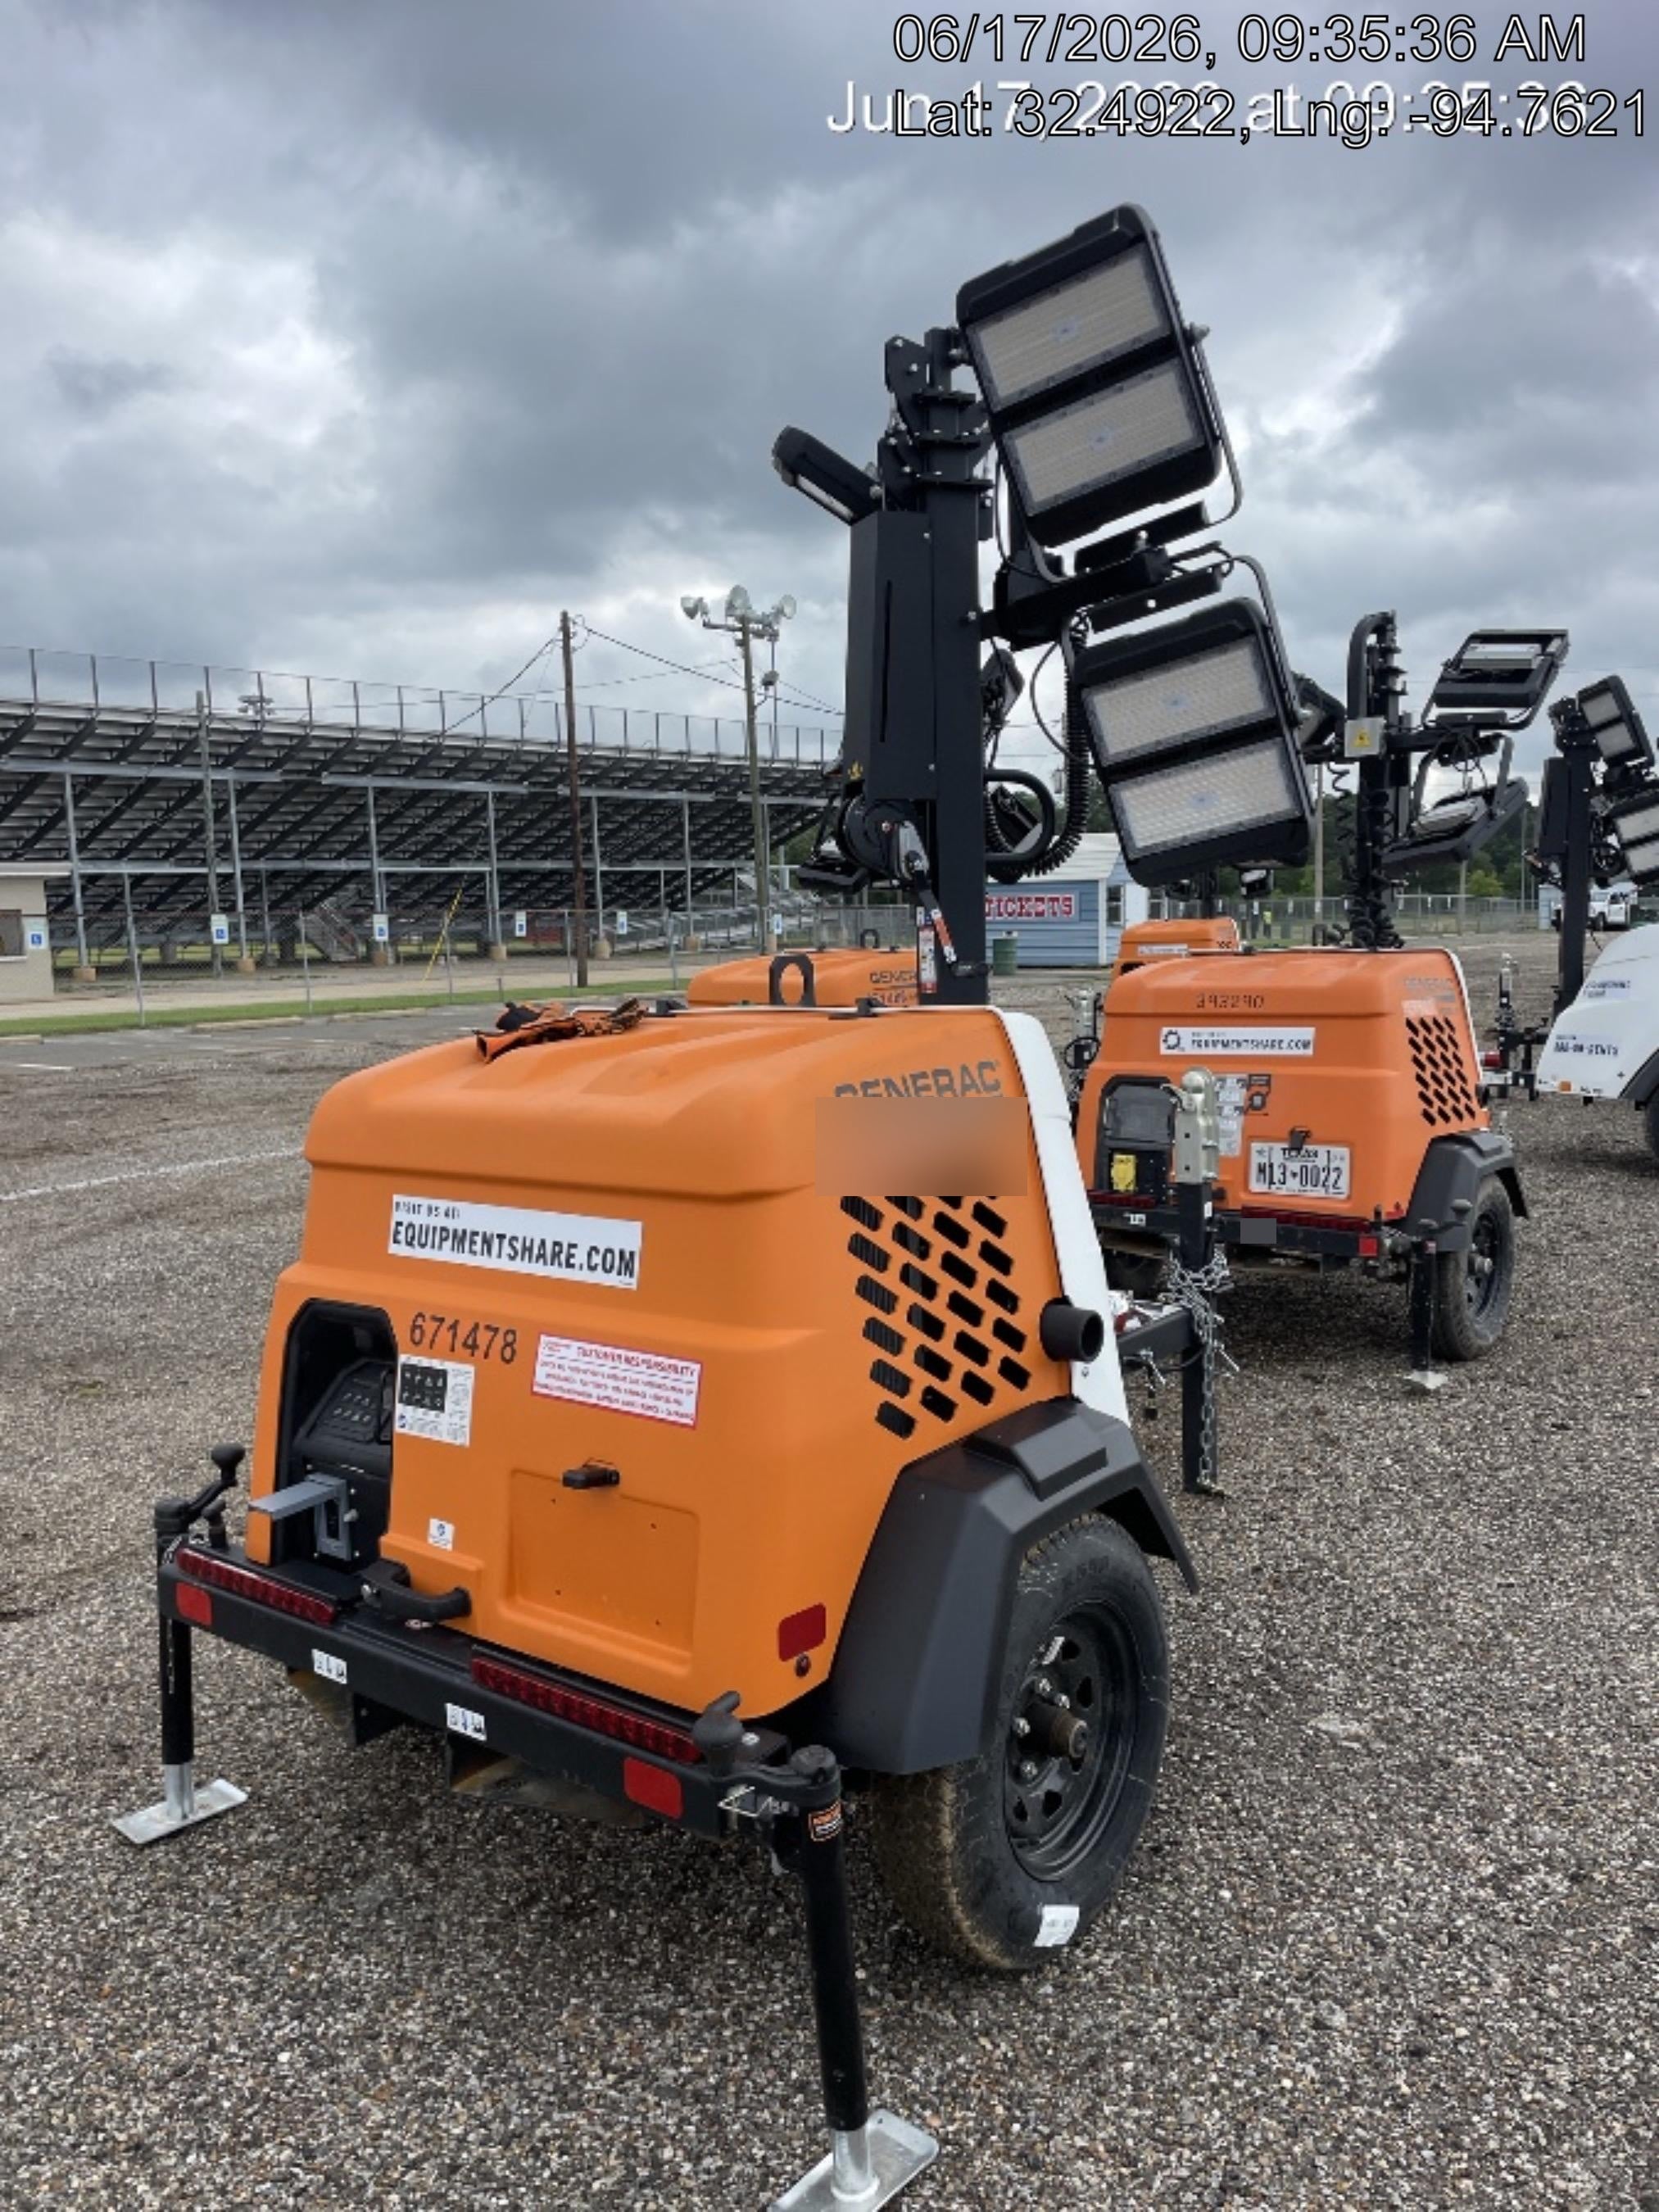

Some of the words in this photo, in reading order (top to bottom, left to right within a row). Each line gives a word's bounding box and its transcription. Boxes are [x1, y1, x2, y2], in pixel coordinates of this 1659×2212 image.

[985, 895, 1074, 918] TICKETS
[392, 1221, 636, 1279] EQUIPMENTSHARE.COM
[410, 1311, 517, 1364] 671478
